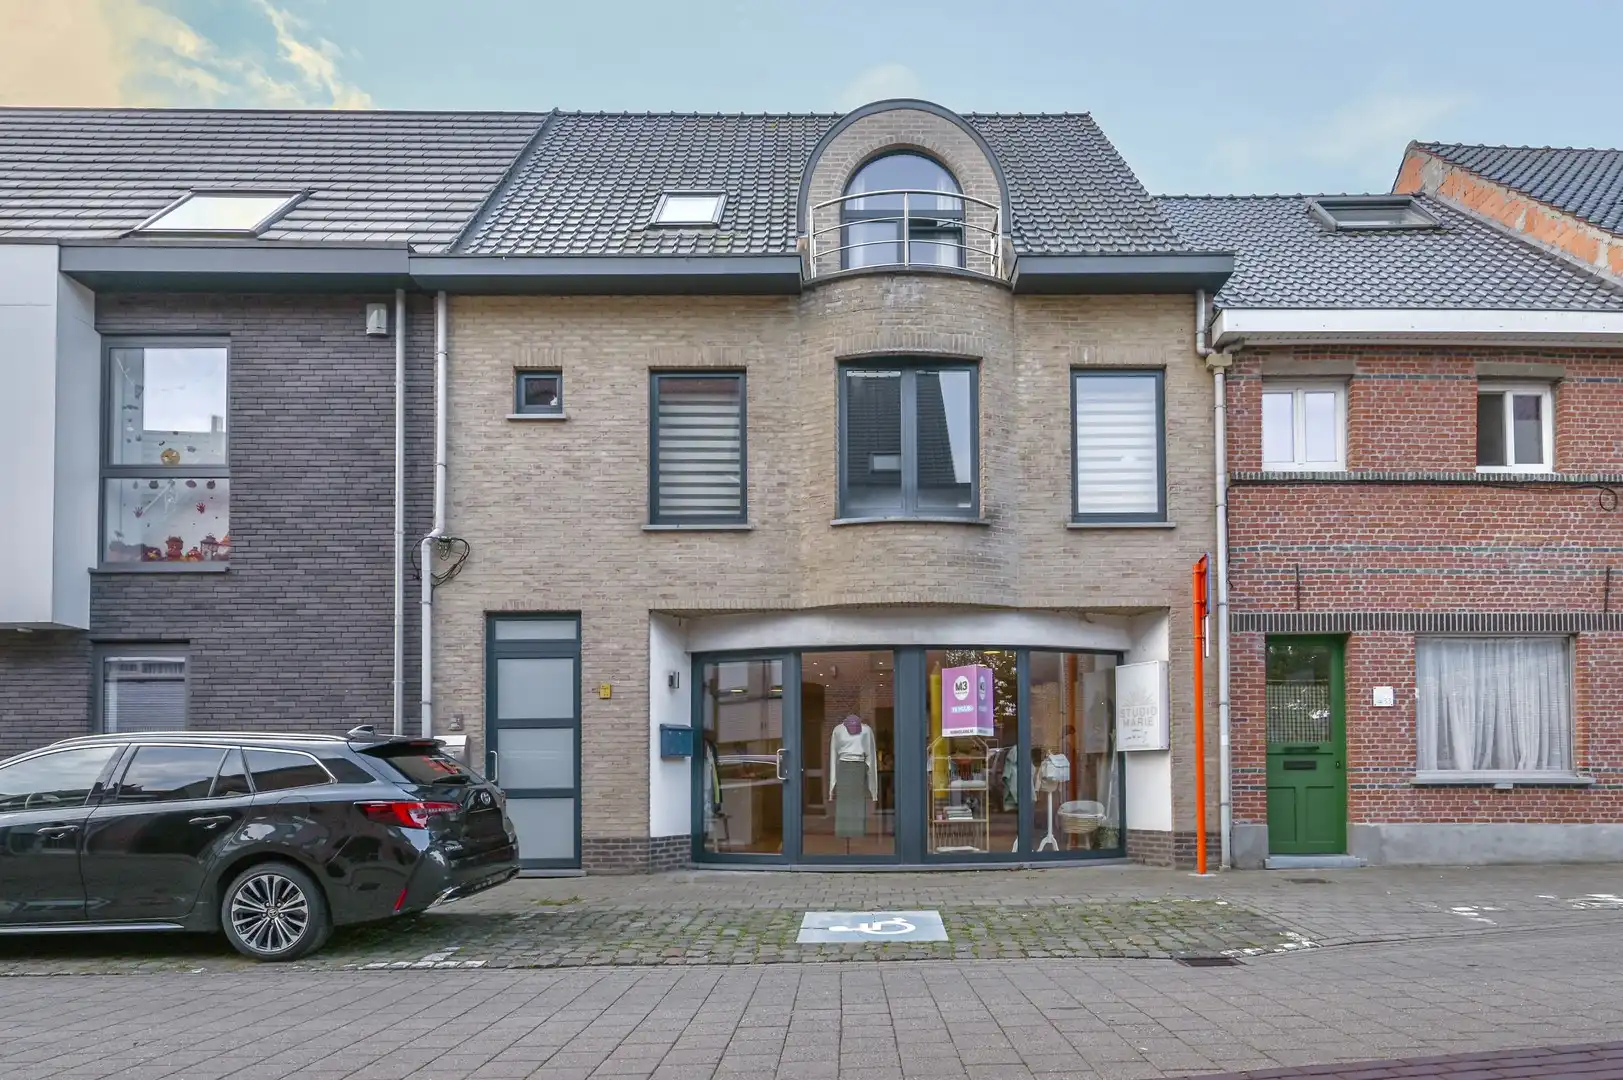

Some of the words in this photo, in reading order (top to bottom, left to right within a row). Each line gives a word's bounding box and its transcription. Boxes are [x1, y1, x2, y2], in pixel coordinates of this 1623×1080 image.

[955, 681, 968, 691] M3
[1120, 706, 1157, 718] STUDIO
[1123, 716, 1153, 728] MARIE
